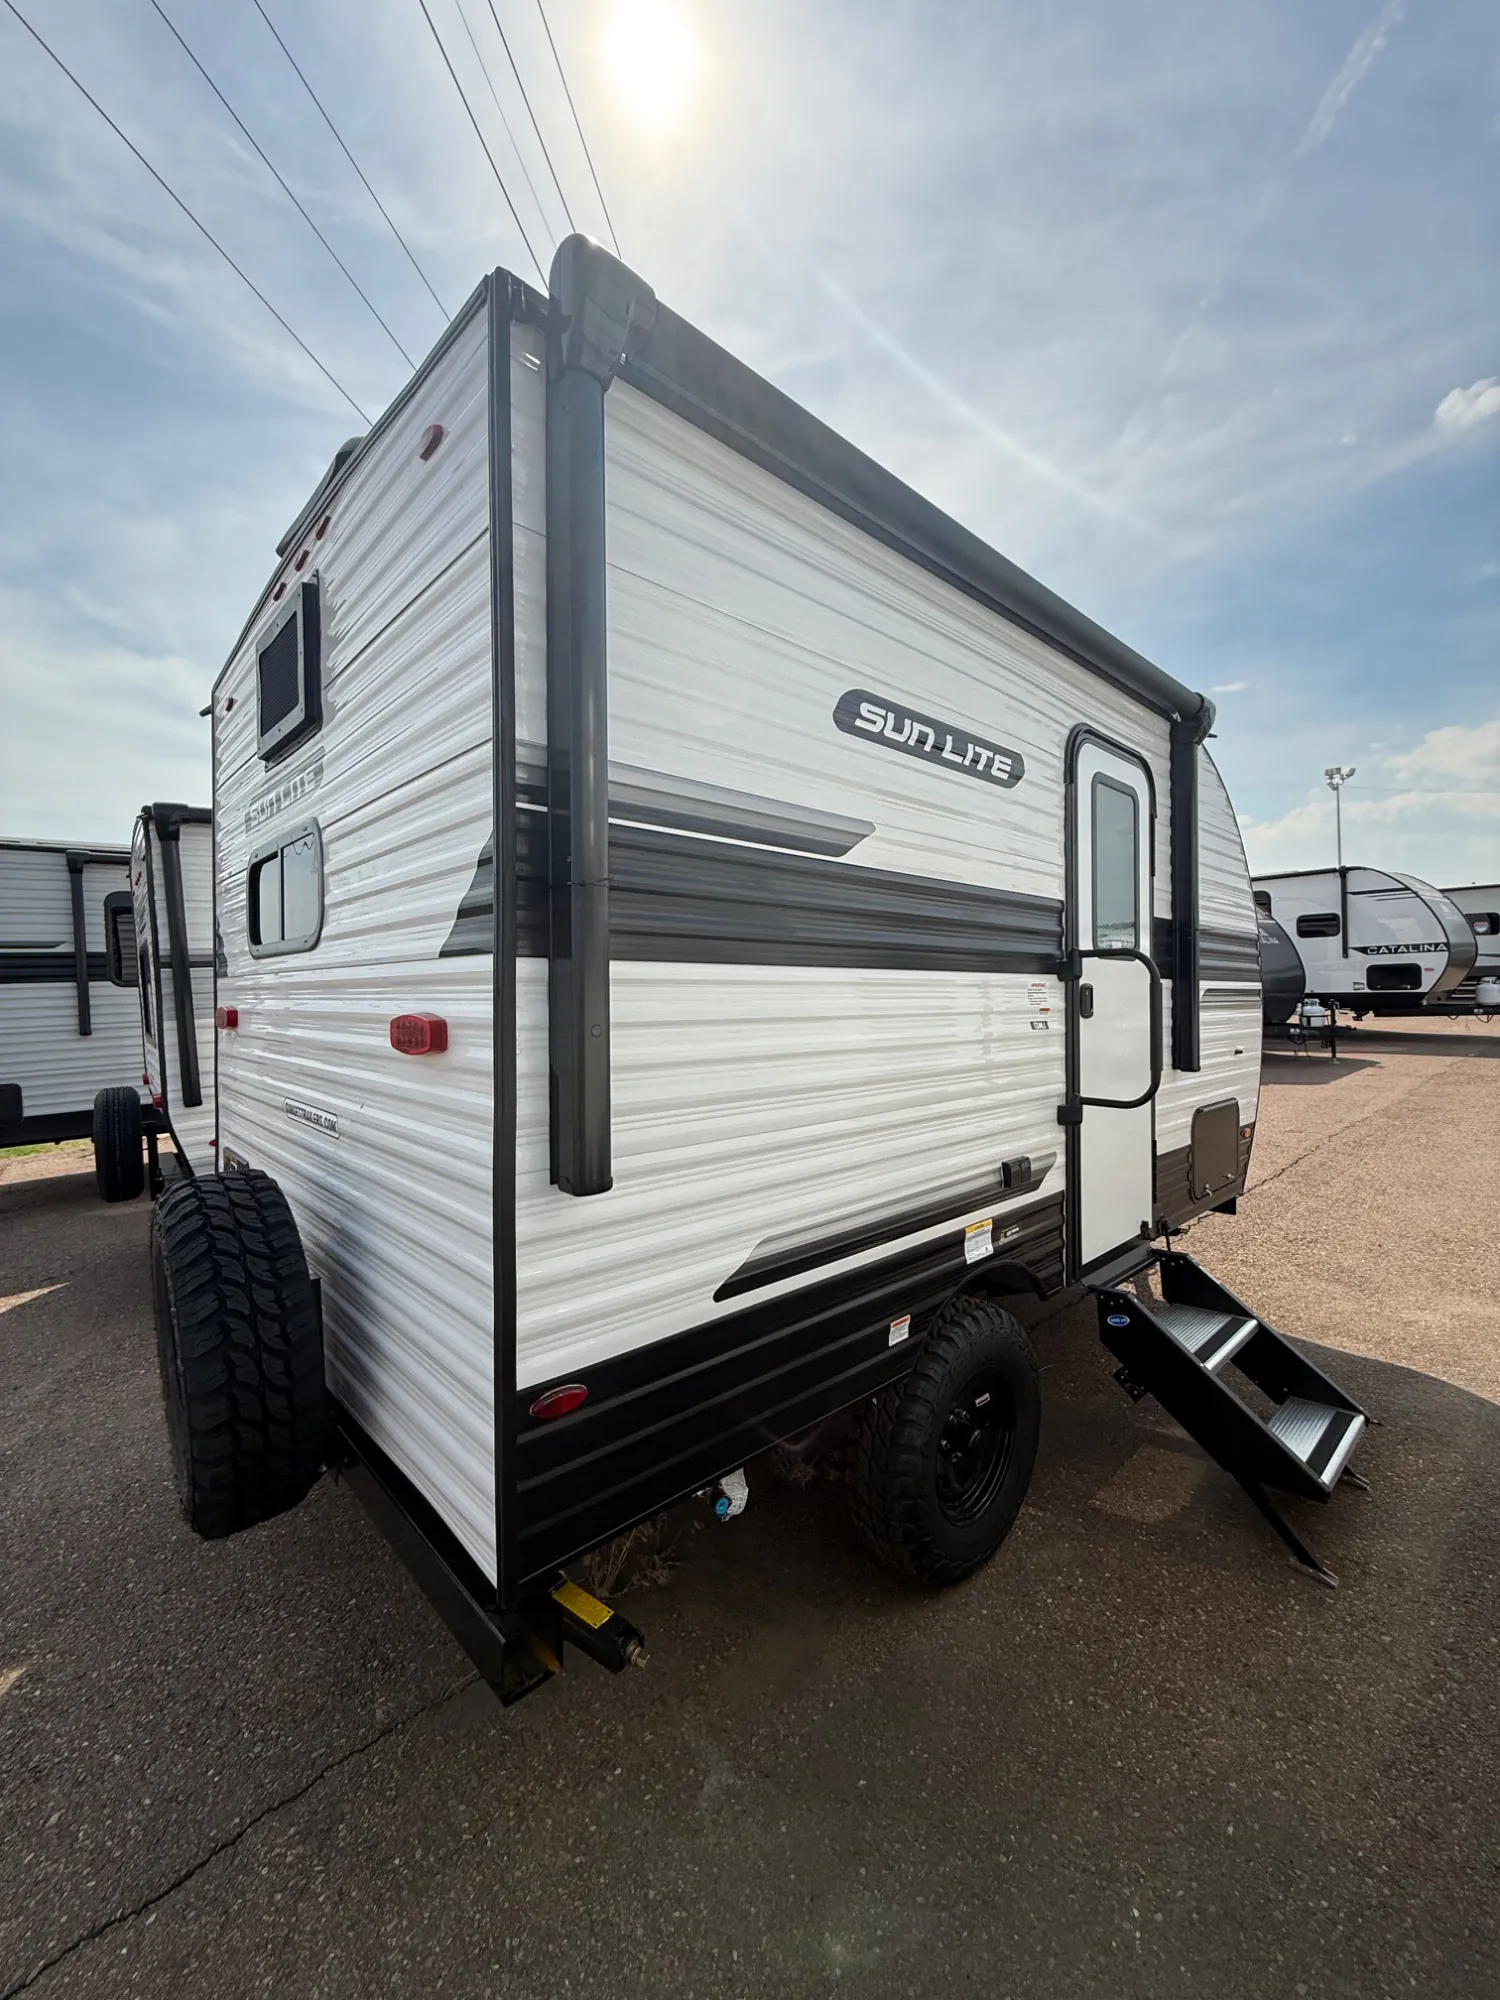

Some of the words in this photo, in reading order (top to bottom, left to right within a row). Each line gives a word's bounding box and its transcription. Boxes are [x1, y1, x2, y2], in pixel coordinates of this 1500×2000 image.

[854, 702, 935, 752] SUN
[941, 734, 1012, 780] LITE
[1367, 943, 1448, 954] CATALINA
